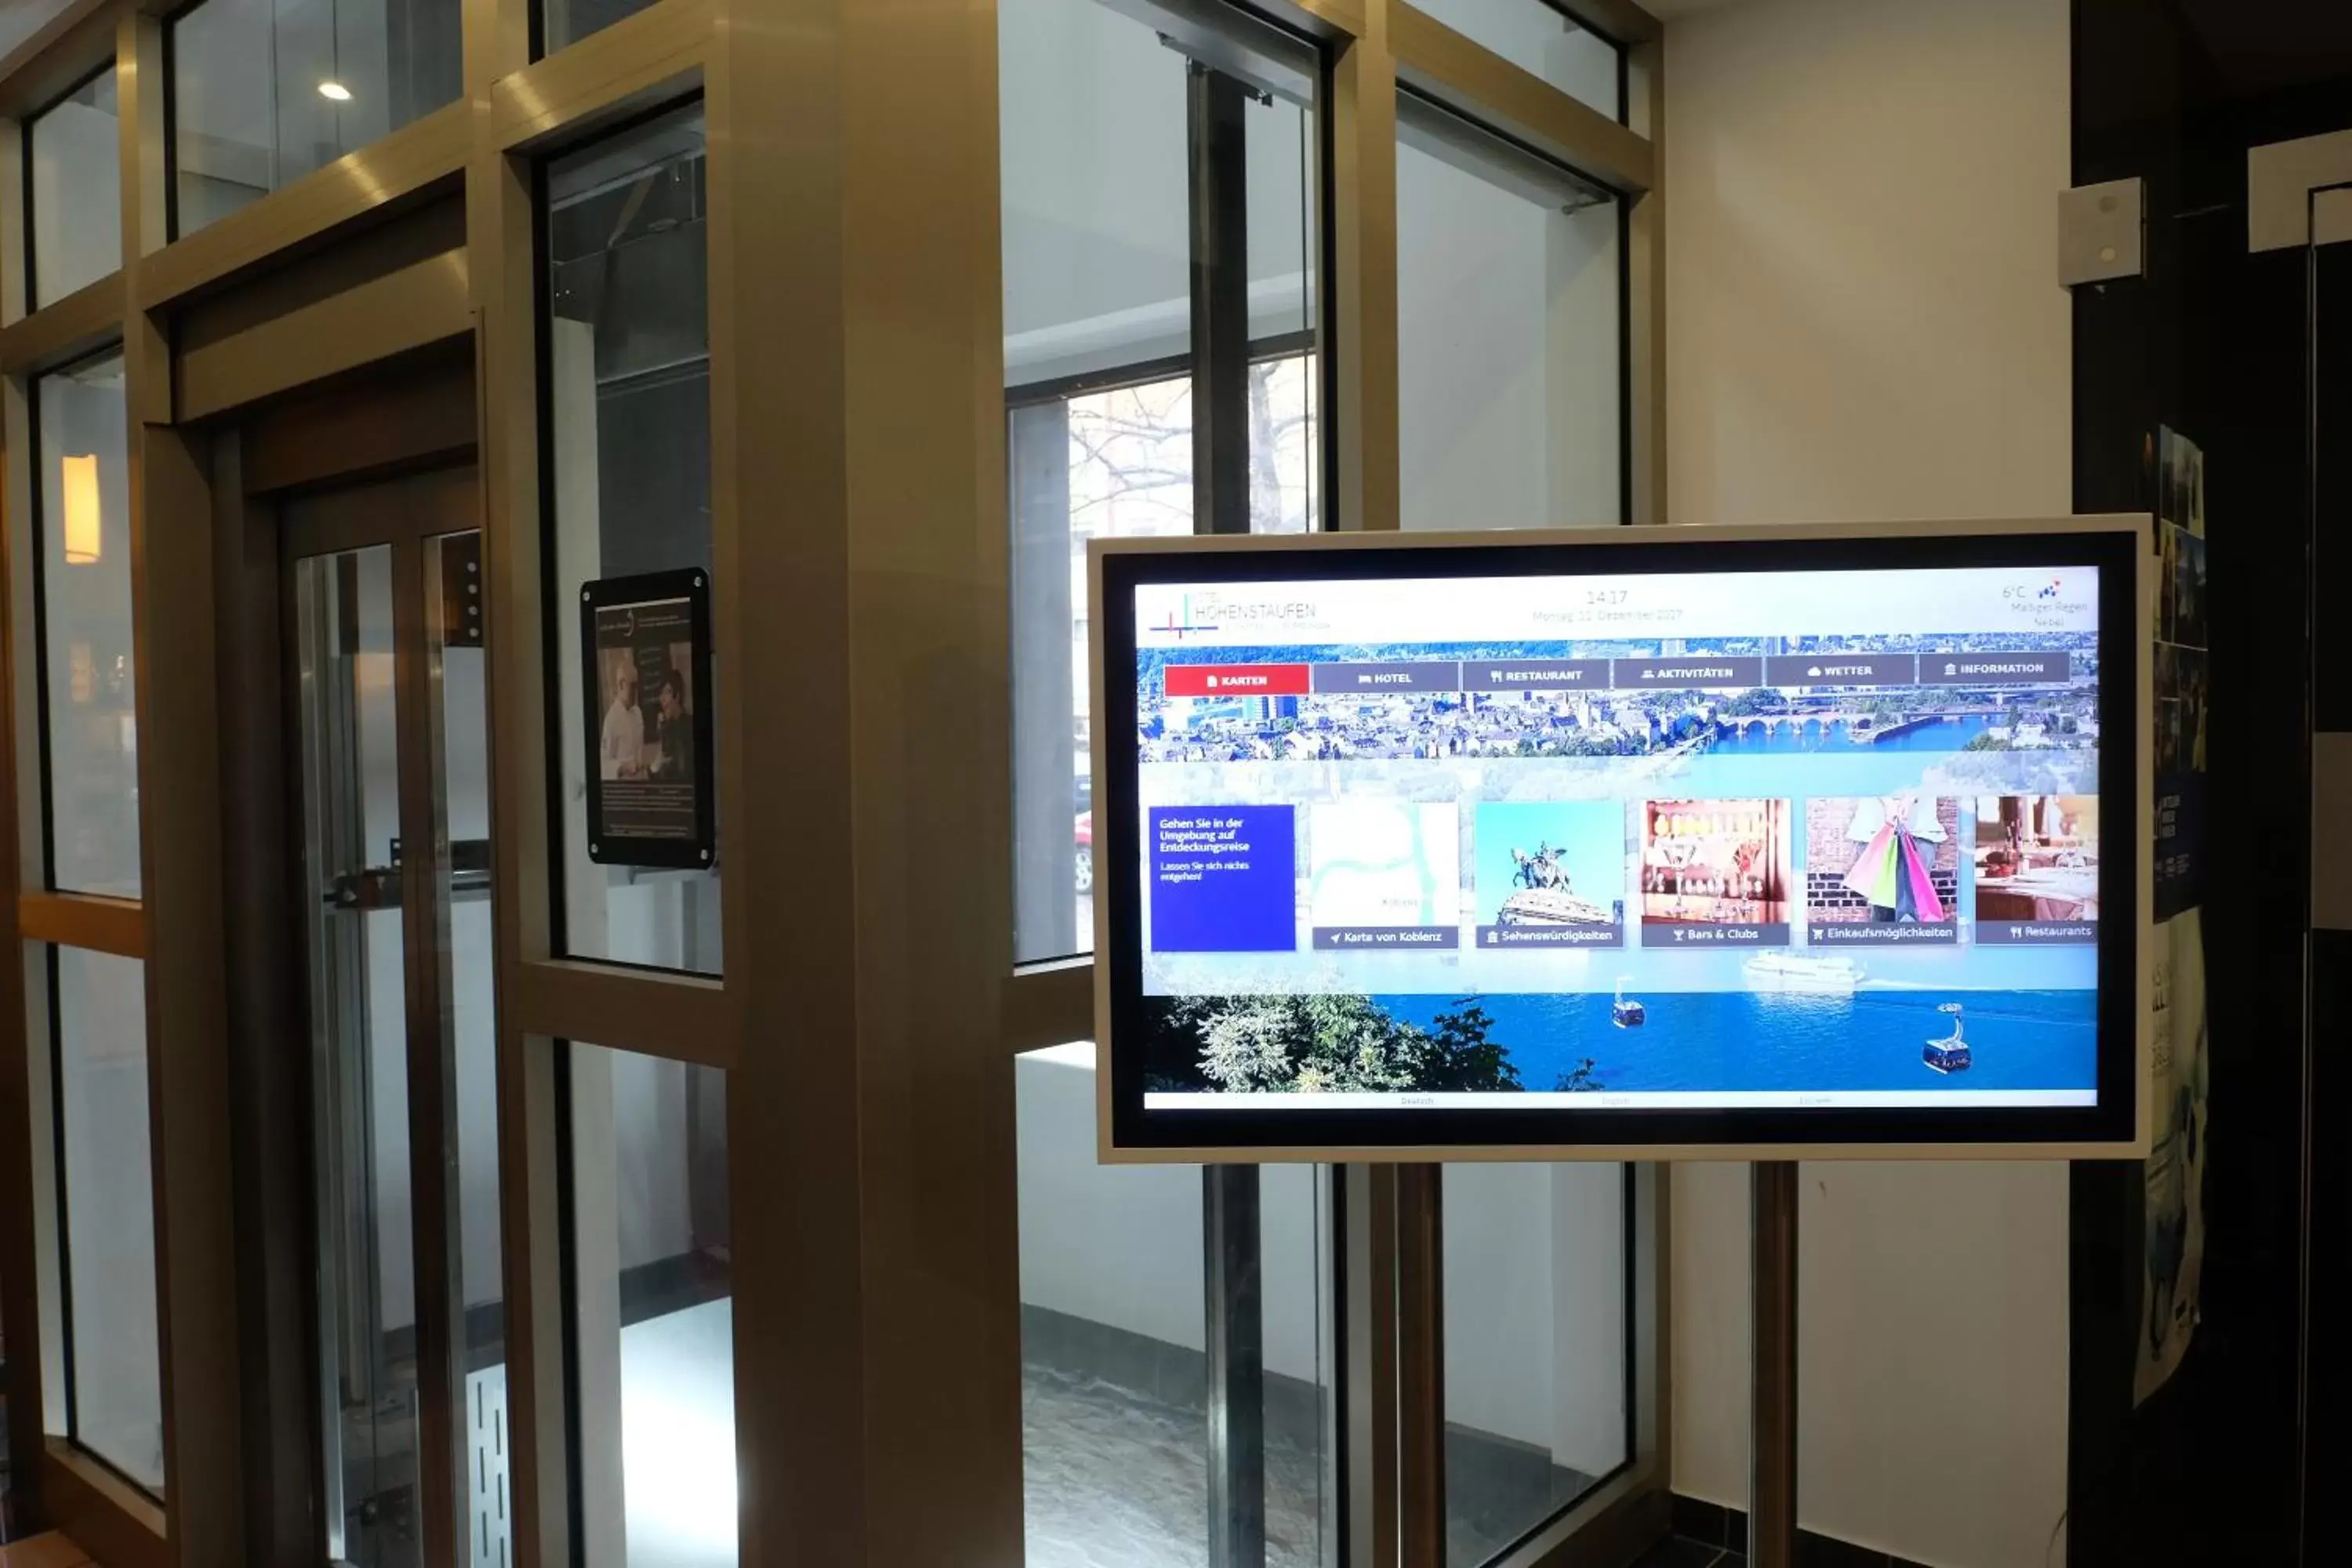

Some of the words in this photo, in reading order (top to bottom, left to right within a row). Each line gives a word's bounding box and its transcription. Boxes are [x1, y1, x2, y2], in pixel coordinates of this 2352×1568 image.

[1586, 590, 1628, 604] 1417
[2002, 586, 2027, 599] 6°C
[1195, 602, 1317, 619] HOHENSTAUFEN
[1657, 667, 1733, 679] AKTIVITÄTEN
[1824, 666, 1872, 676] WETTER
[1960, 663, 2044, 674] INFORMATION
[1221, 675, 1268, 685] KARTEN
[1374, 673, 1412, 684] HOTEL
[1506, 670, 1583, 681] RESTAURANT
[1160, 818, 1194, 829] Gehen
[1196, 818, 1211, 829] Sie
[1213, 818, 1224, 829] in
[1225, 818, 1244, 829] der
[1160, 830, 1216, 843] Umgebung
[1218, 829, 1236, 840] auf
[1160, 841, 1250, 854] Entdeckungsreise
[1160, 862, 1190, 871] Lassen
[1191, 862, 1205, 871] Sie
[1206, 861, 1223, 870] sich
[1224, 861, 1250, 870] nichts
[1344, 932, 1373, 942] Karte
[1376, 933, 1396, 942] von
[1399, 931, 1442, 942] Koblenz
[1501, 930, 1613, 943] Sehenswürdigkeiten
[1688, 929, 1713, 939] Bars
[1715, 929, 1724, 939] &
[1727, 928, 1759, 939] Clubs
[1828, 927, 1954, 940] Einkaufsmöglichkeiten
[2025, 926, 2092, 937] Restaurants
